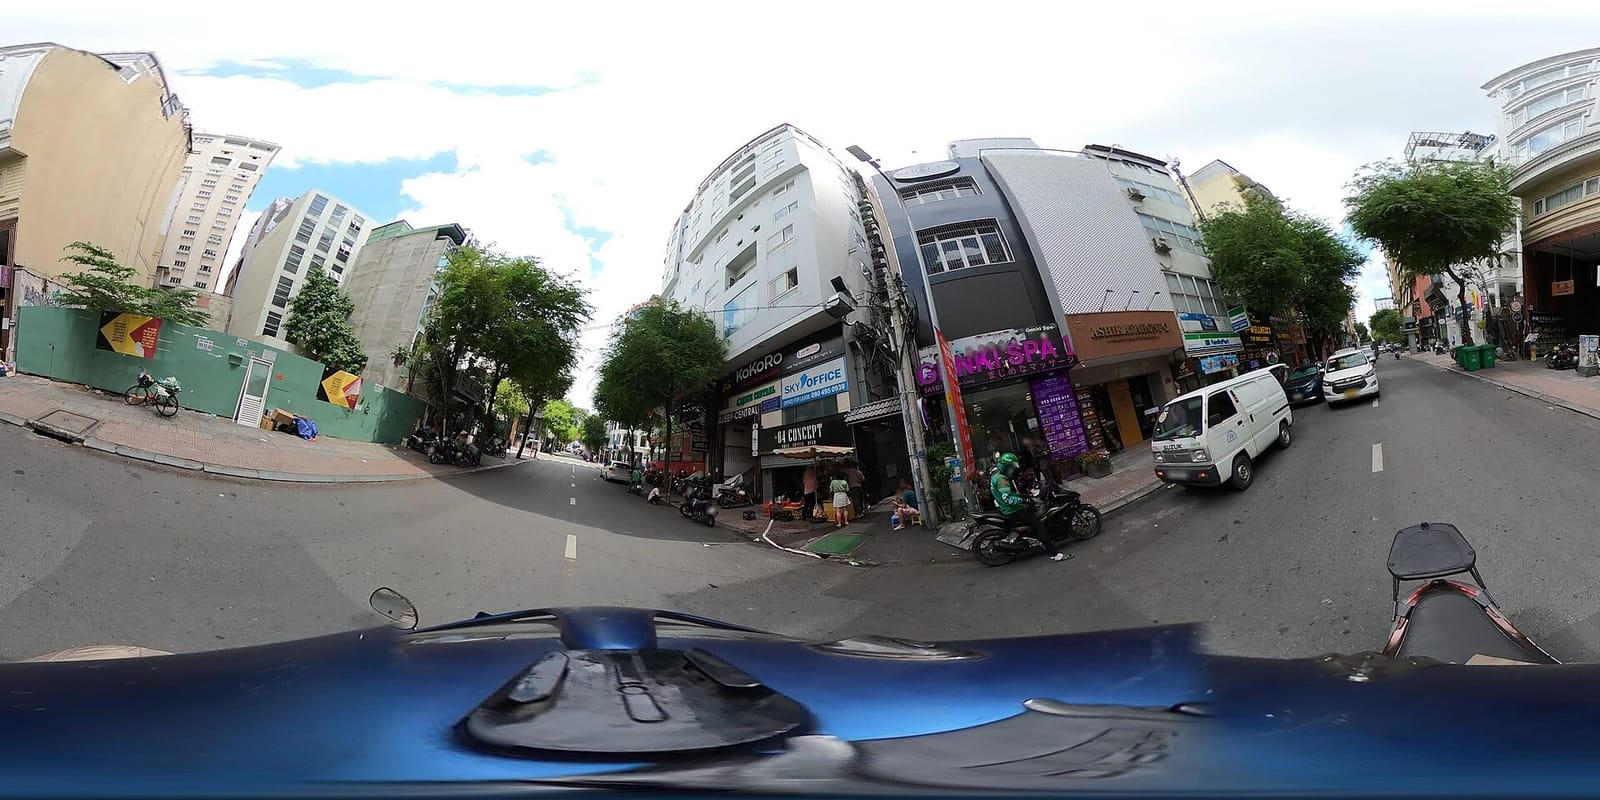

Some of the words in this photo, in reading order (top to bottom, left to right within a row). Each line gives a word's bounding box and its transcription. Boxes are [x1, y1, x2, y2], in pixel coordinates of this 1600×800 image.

[916, 346, 1001, 386] GNKI
[1007, 336, 1059, 366] SPA
[784, 382, 800, 395] SKY
[806, 368, 842, 387] OFFICE
[734, 405, 759, 421] CENTRAL
[788, 423, 823, 442] CONCEPT
